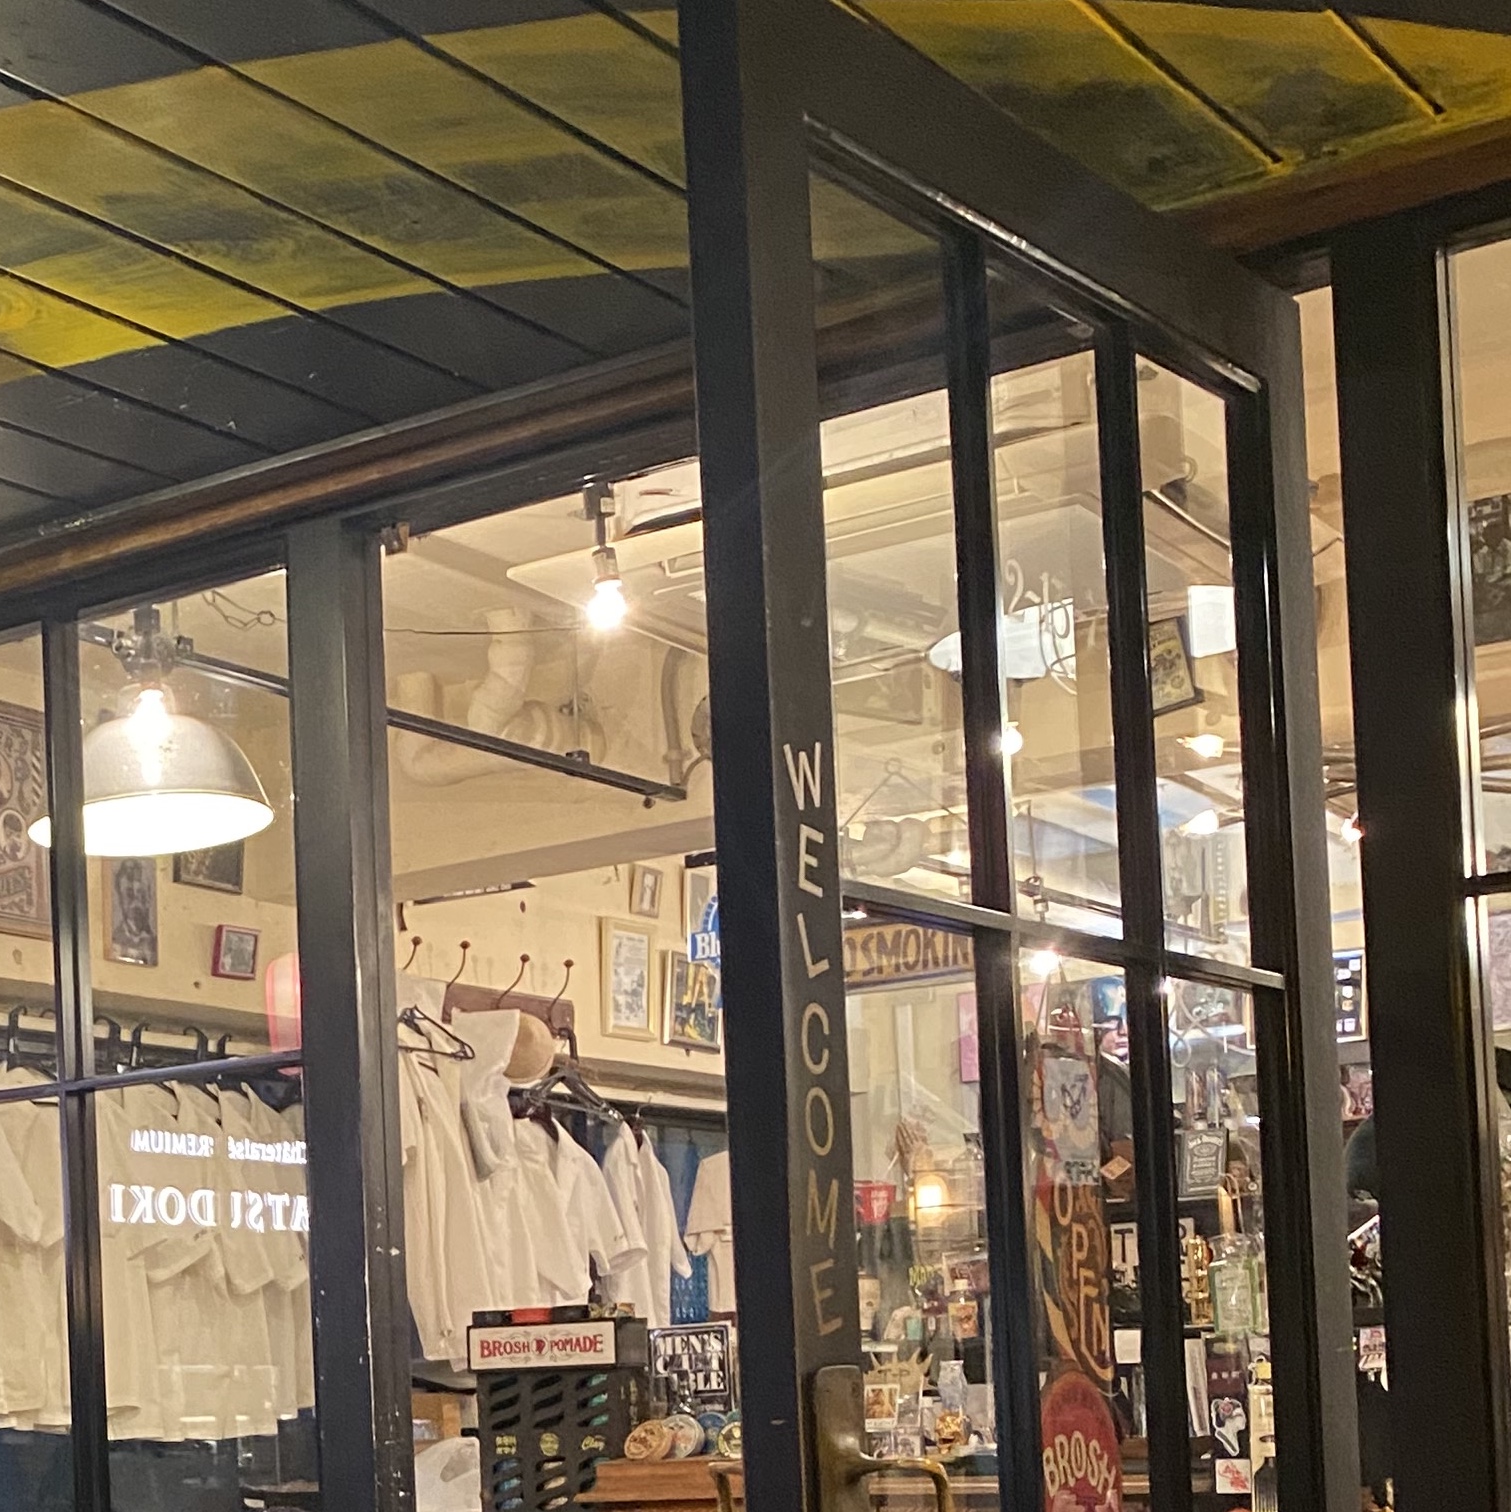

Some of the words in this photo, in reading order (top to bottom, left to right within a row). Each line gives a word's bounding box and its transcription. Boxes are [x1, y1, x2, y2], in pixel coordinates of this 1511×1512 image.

[861, 927, 969, 977] SMOKIN
[783, 741, 843, 1336] WELCOME
[480, 1338, 530, 1358] BROSH
[550, 1334, 604, 1354] POMADE
[1043, 1431, 1117, 1498] BROSH
